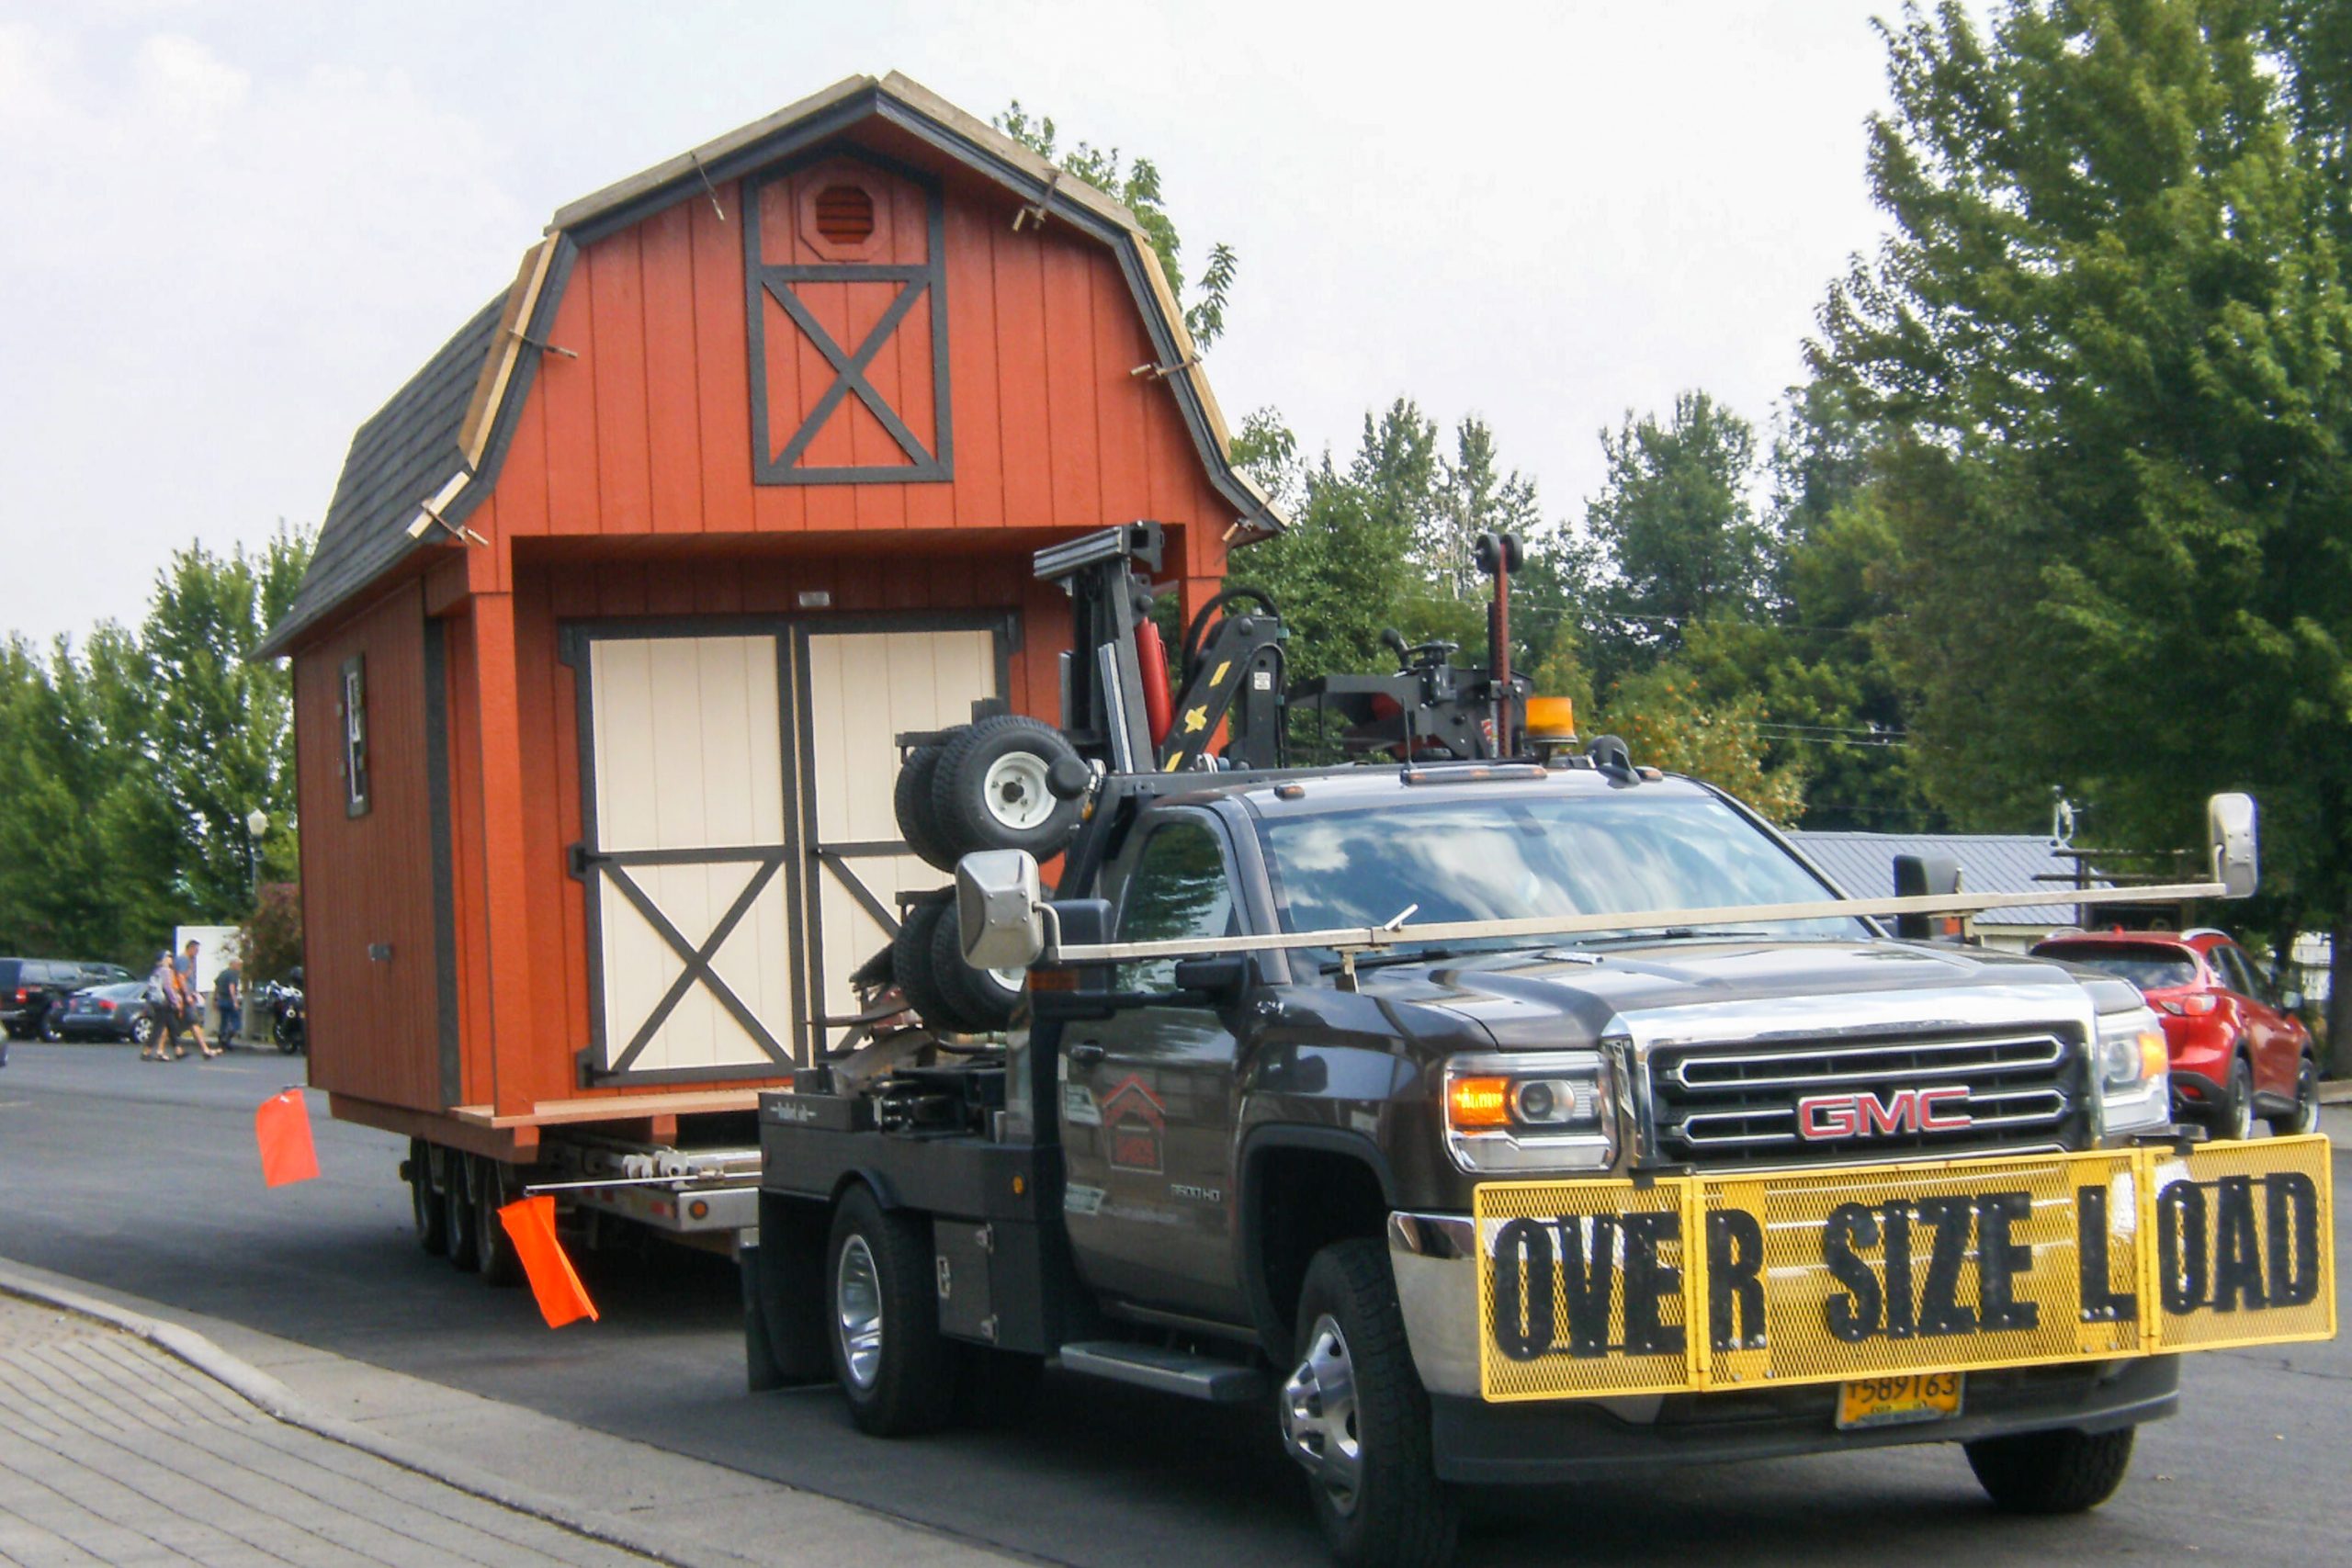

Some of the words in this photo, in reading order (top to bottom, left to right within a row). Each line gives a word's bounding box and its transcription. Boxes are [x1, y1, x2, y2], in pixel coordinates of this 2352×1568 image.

[1798, 1085, 1972, 1141] GMC
[1494, 1209, 1767, 1362] OVER
[1824, 1191, 2040, 1343] SIZE
[2077, 1172, 2320, 1323] LOAD
